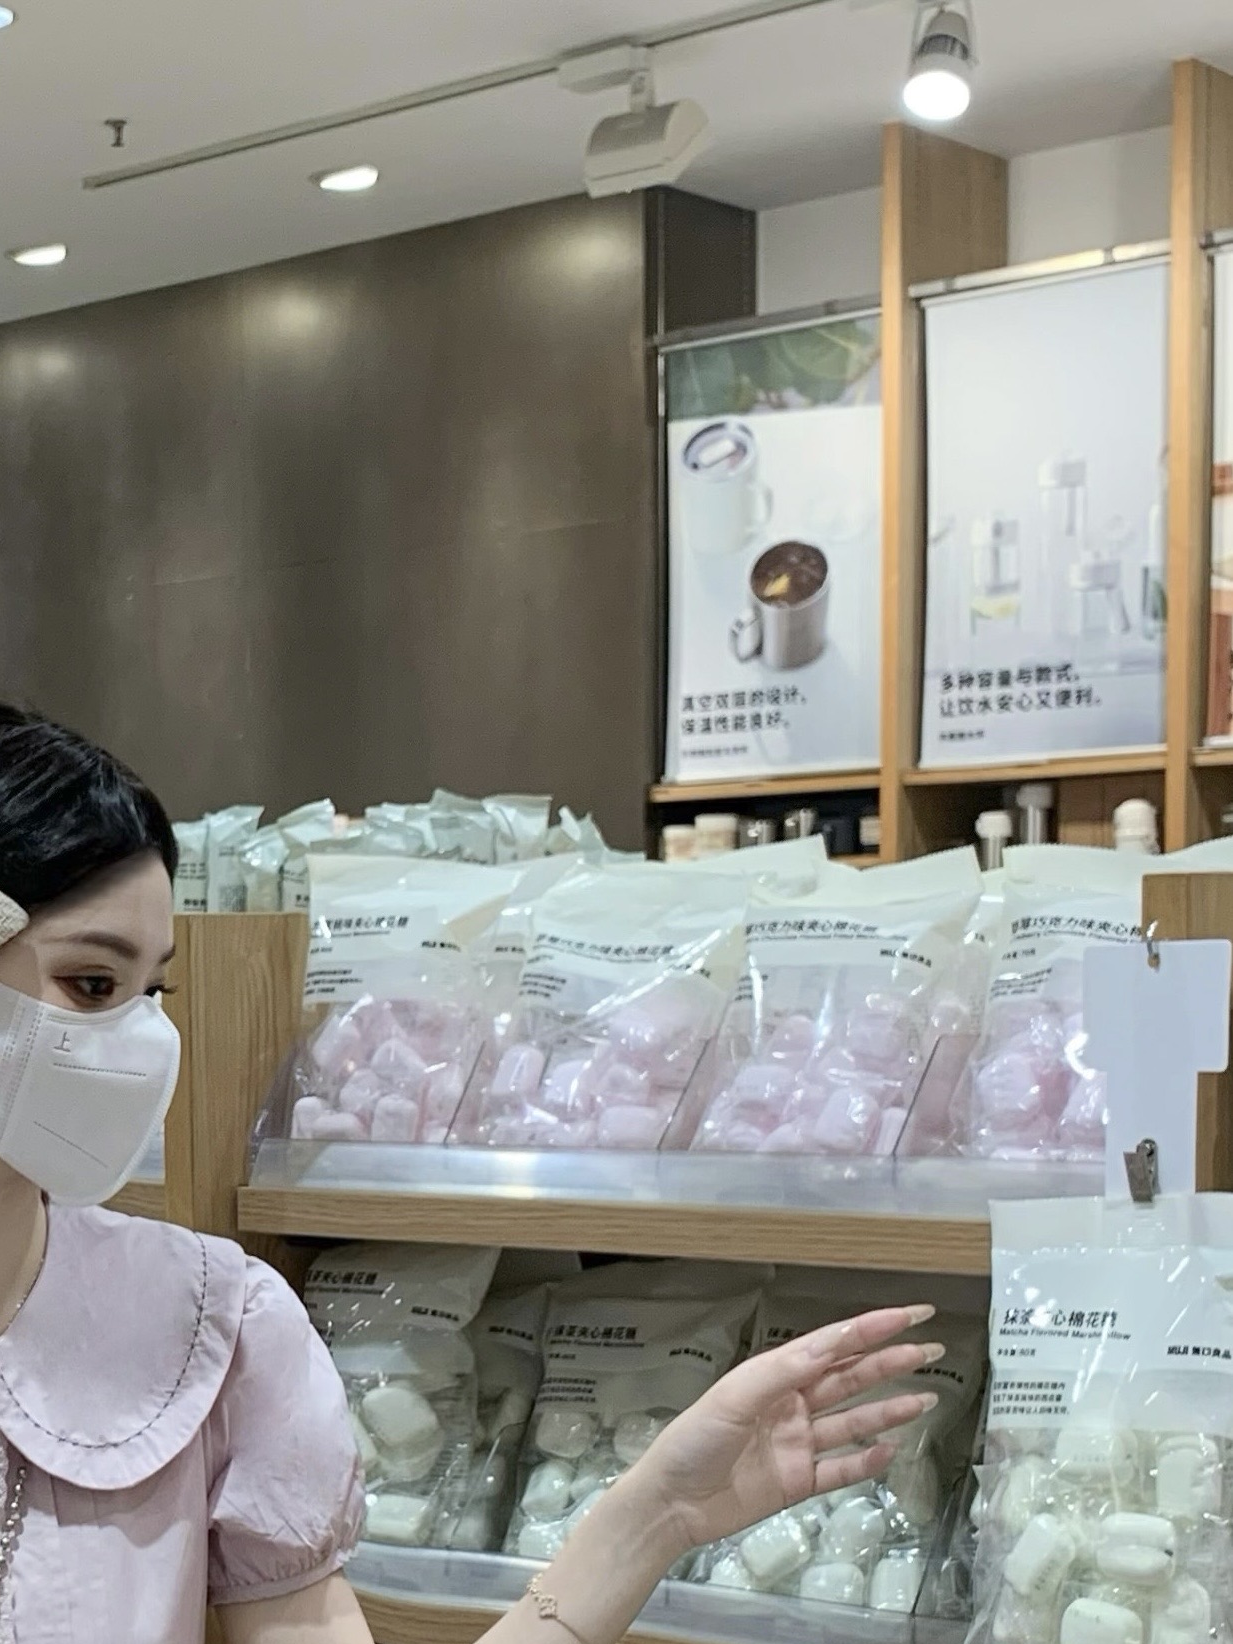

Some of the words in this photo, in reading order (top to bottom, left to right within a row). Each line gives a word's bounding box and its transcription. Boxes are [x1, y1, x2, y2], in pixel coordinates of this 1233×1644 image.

[1003, 1308, 1118, 1328] 抹茶心棉花糖
[999, 1328, 1028, 1337] Matcha
[1167, 1345, 1189, 1356] MUJI
